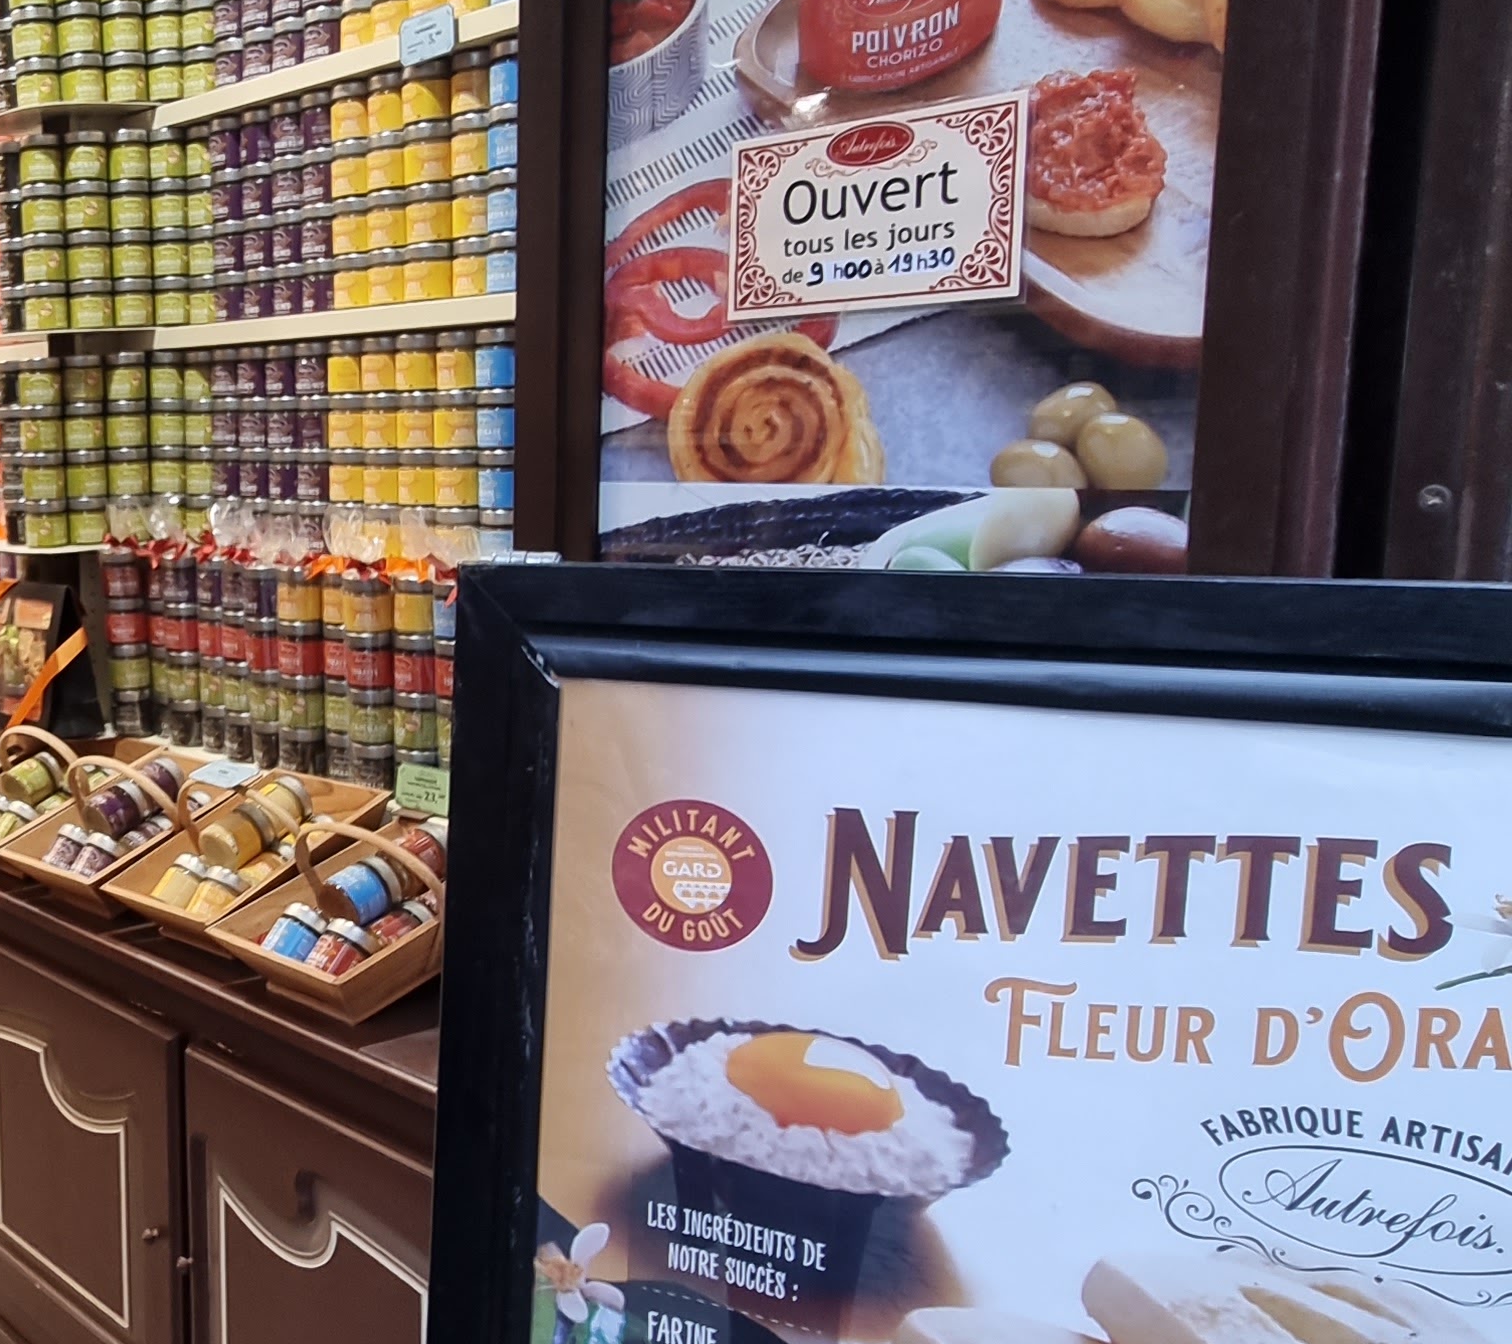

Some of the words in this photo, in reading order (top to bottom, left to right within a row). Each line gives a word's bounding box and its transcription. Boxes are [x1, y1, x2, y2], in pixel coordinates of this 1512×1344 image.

[851, 1, 960, 55] POIVRON
[866, 37, 944, 69] CHORIZO
[782, 160, 959, 226] Ouvert
[783, 236, 835, 258] tous
[844, 229, 879, 252] les
[886, 221, 956, 252] jours
[781, 268, 804, 285] de
[805, 261, 825, 287] 9
[626, 809, 756, 861] MILITANT
[662, 860, 723, 879] GARD
[790, 806, 1459, 963] NAVETTES
[642, 902, 676, 934] DU
[682, 907, 744, 943] GOÛT
[983, 976, 1216, 1068] FLEUR
[1199, 1105, 1365, 1147] FABRIQUE
[646, 1200, 678, 1231] LES
[682, 1207, 798, 1263] INGRÉDIENTS
[801, 1238, 827, 1272] DE
[667, 1241, 720, 1281] NOTRE
[724, 1256, 787, 1300] SUCCÈS
